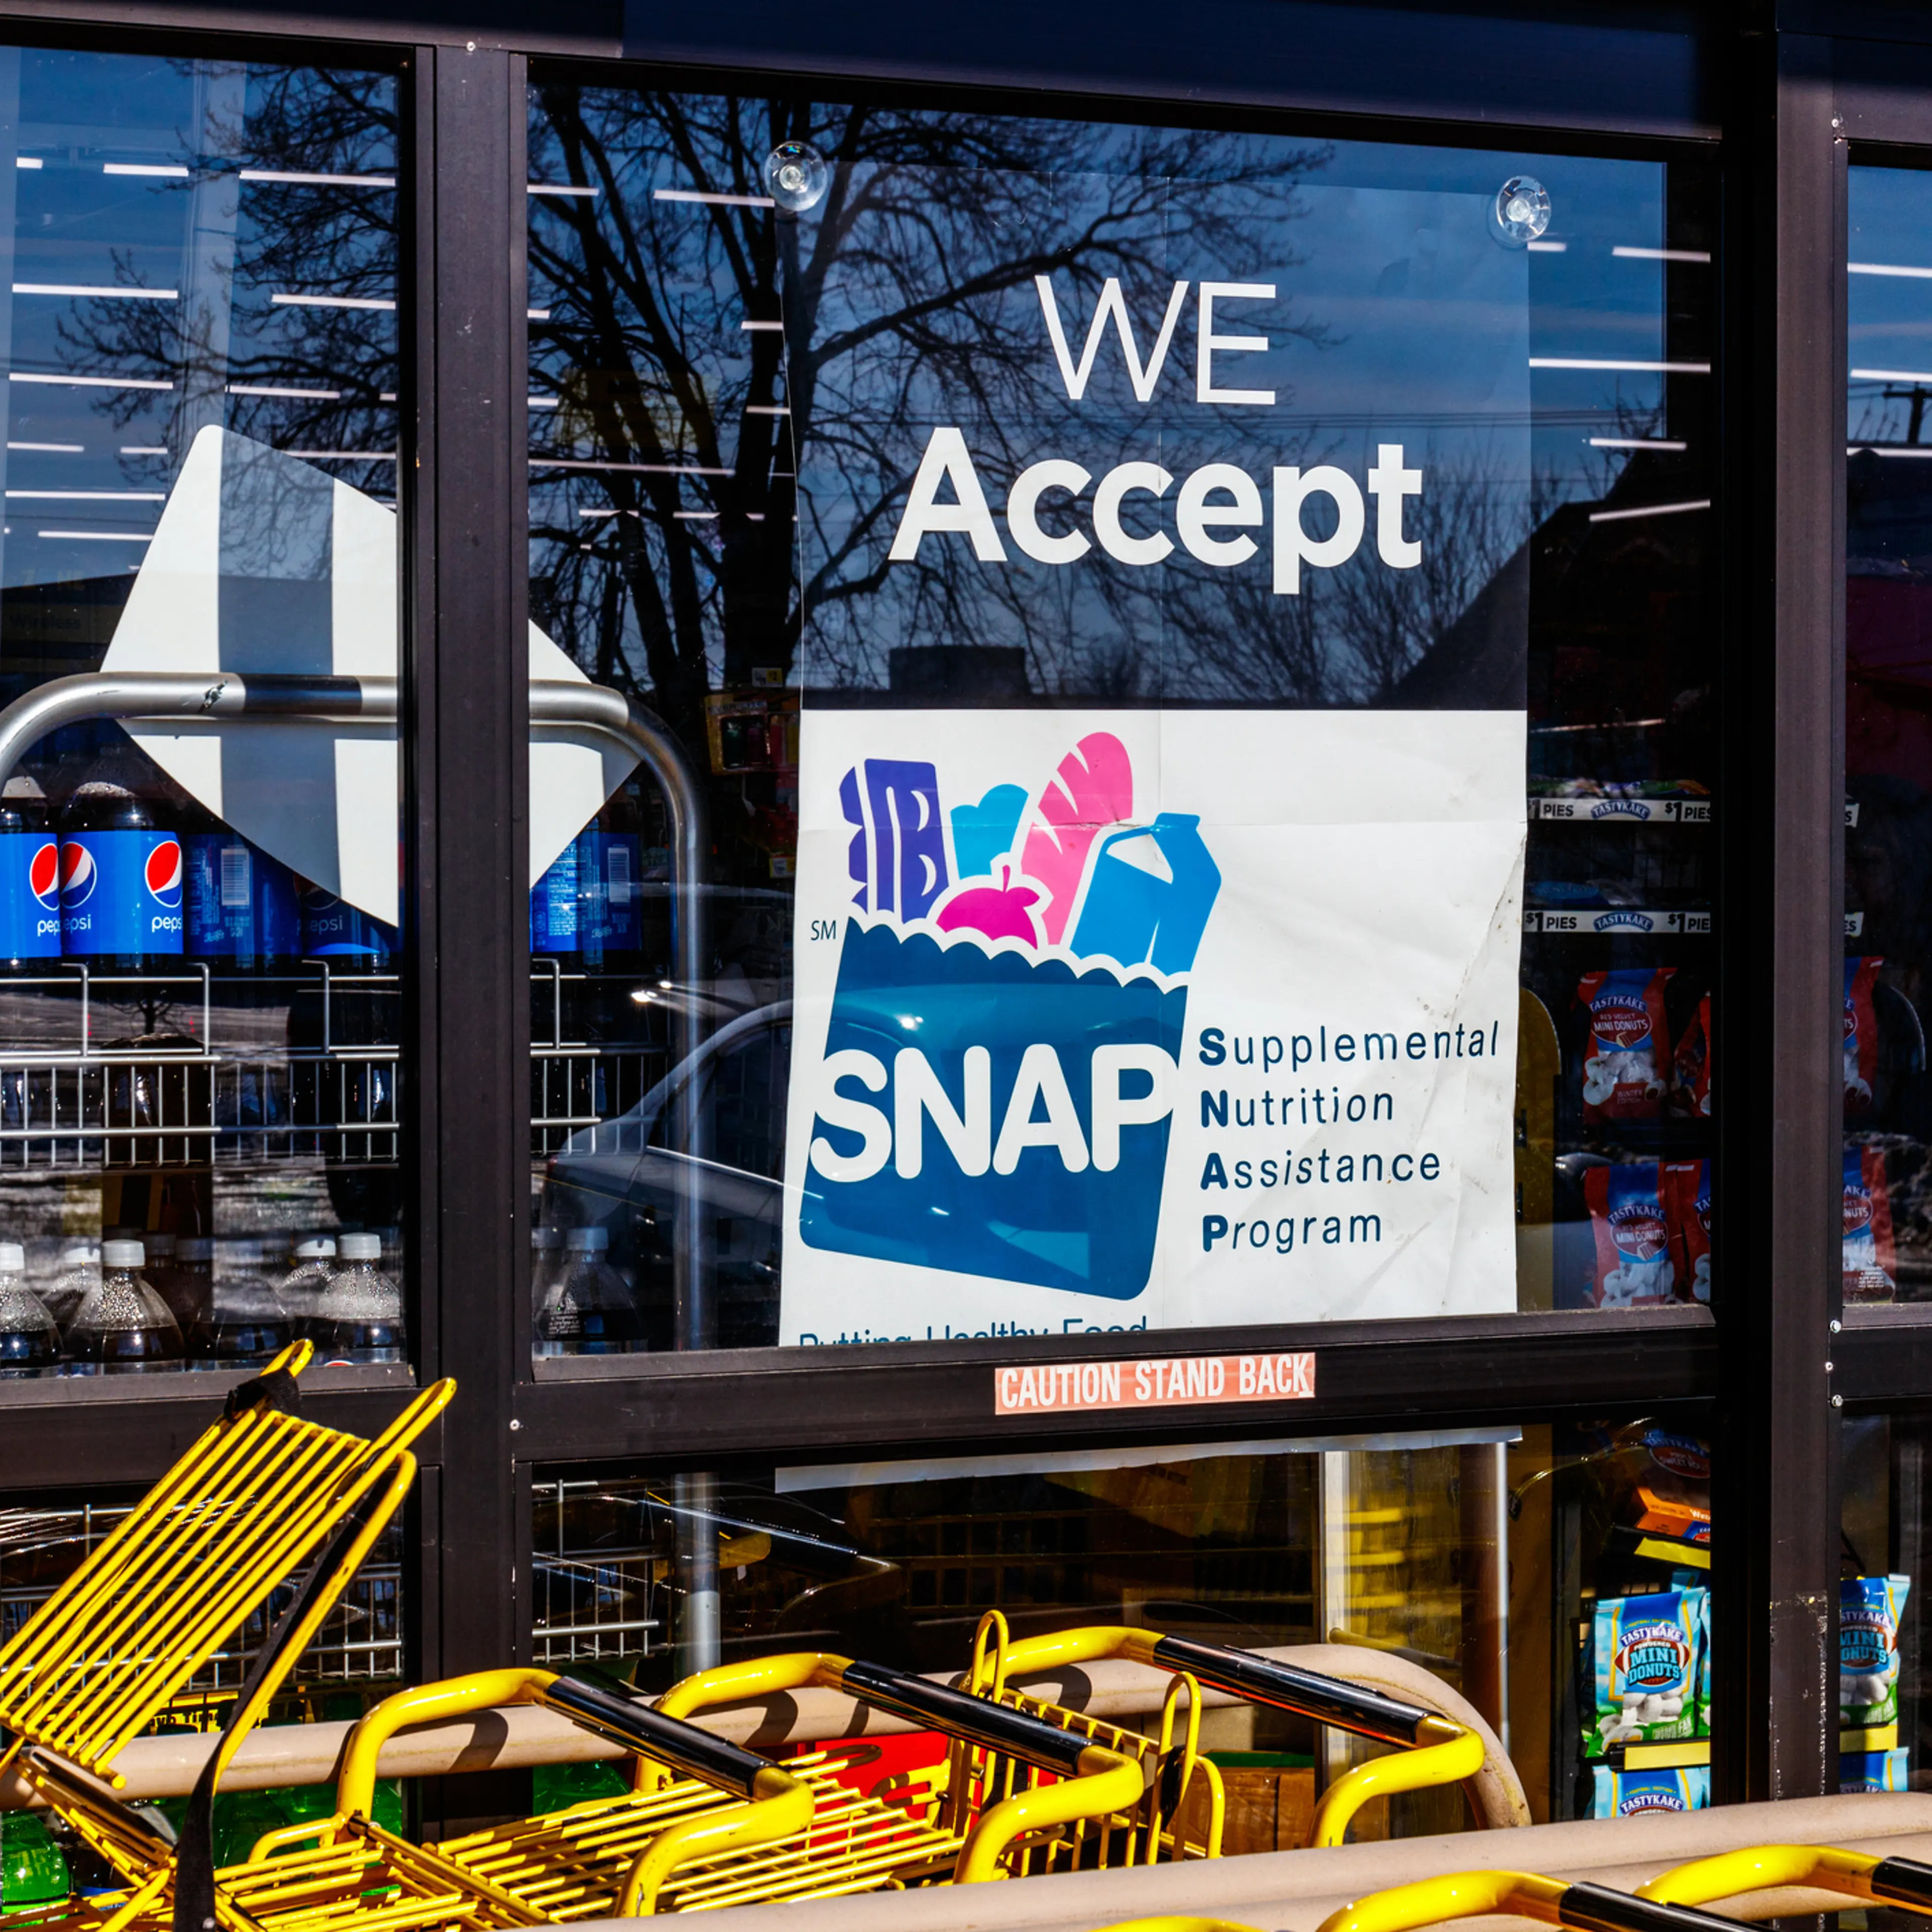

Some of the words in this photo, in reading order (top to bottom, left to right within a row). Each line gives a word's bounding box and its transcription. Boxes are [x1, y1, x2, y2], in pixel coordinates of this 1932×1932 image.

[1035, 275, 1275, 405] WE
[888, 427, 1422, 594] Accept
[1544, 804, 1574, 817] PIES
[1593, 801, 1648, 818] TASTYKAKE
[1665, 802, 1682, 823] $1
[811, 920, 836, 940] SM
[1525, 912, 1543, 932] $1
[1547, 917, 1577, 929] PIES
[1595, 913, 1651, 929] TASTYKAKE
[1668, 913, 1685, 933] $1
[1688, 918, 1710, 930] PIE
[1589, 996, 1644, 1011] TASTYKAKE
[1593, 1021, 1613, 1031] MINI
[1614, 1019, 1648, 1031] DONUTS
[1199, 1020, 1498, 1073] Supplemental
[810, 1043, 1179, 1182] SNAP
[1200, 1087, 1393, 1128] Nutrition
[1200, 1149, 1440, 1190] Assistance
[1608, 1205, 1665, 1224] TASTYKAKE
[1202, 1214, 1382, 1254] Program
[1636, 1229, 1665, 1241] DONUTS
[1001, 1363, 1120, 1408] CAUTION
[1135, 1358, 1224, 1399] STAND
[1239, 1354, 1309, 1396] BACK
[1621, 1626, 1682, 1646] TASTYKAKE
[1630, 1647, 1677, 1667] MINI
[1840, 1646, 1887, 1663] ONUTS
[1628, 1662, 1680, 1685] DONUTS
[1621, 1794, 1682, 1814] TASTYKAKE
